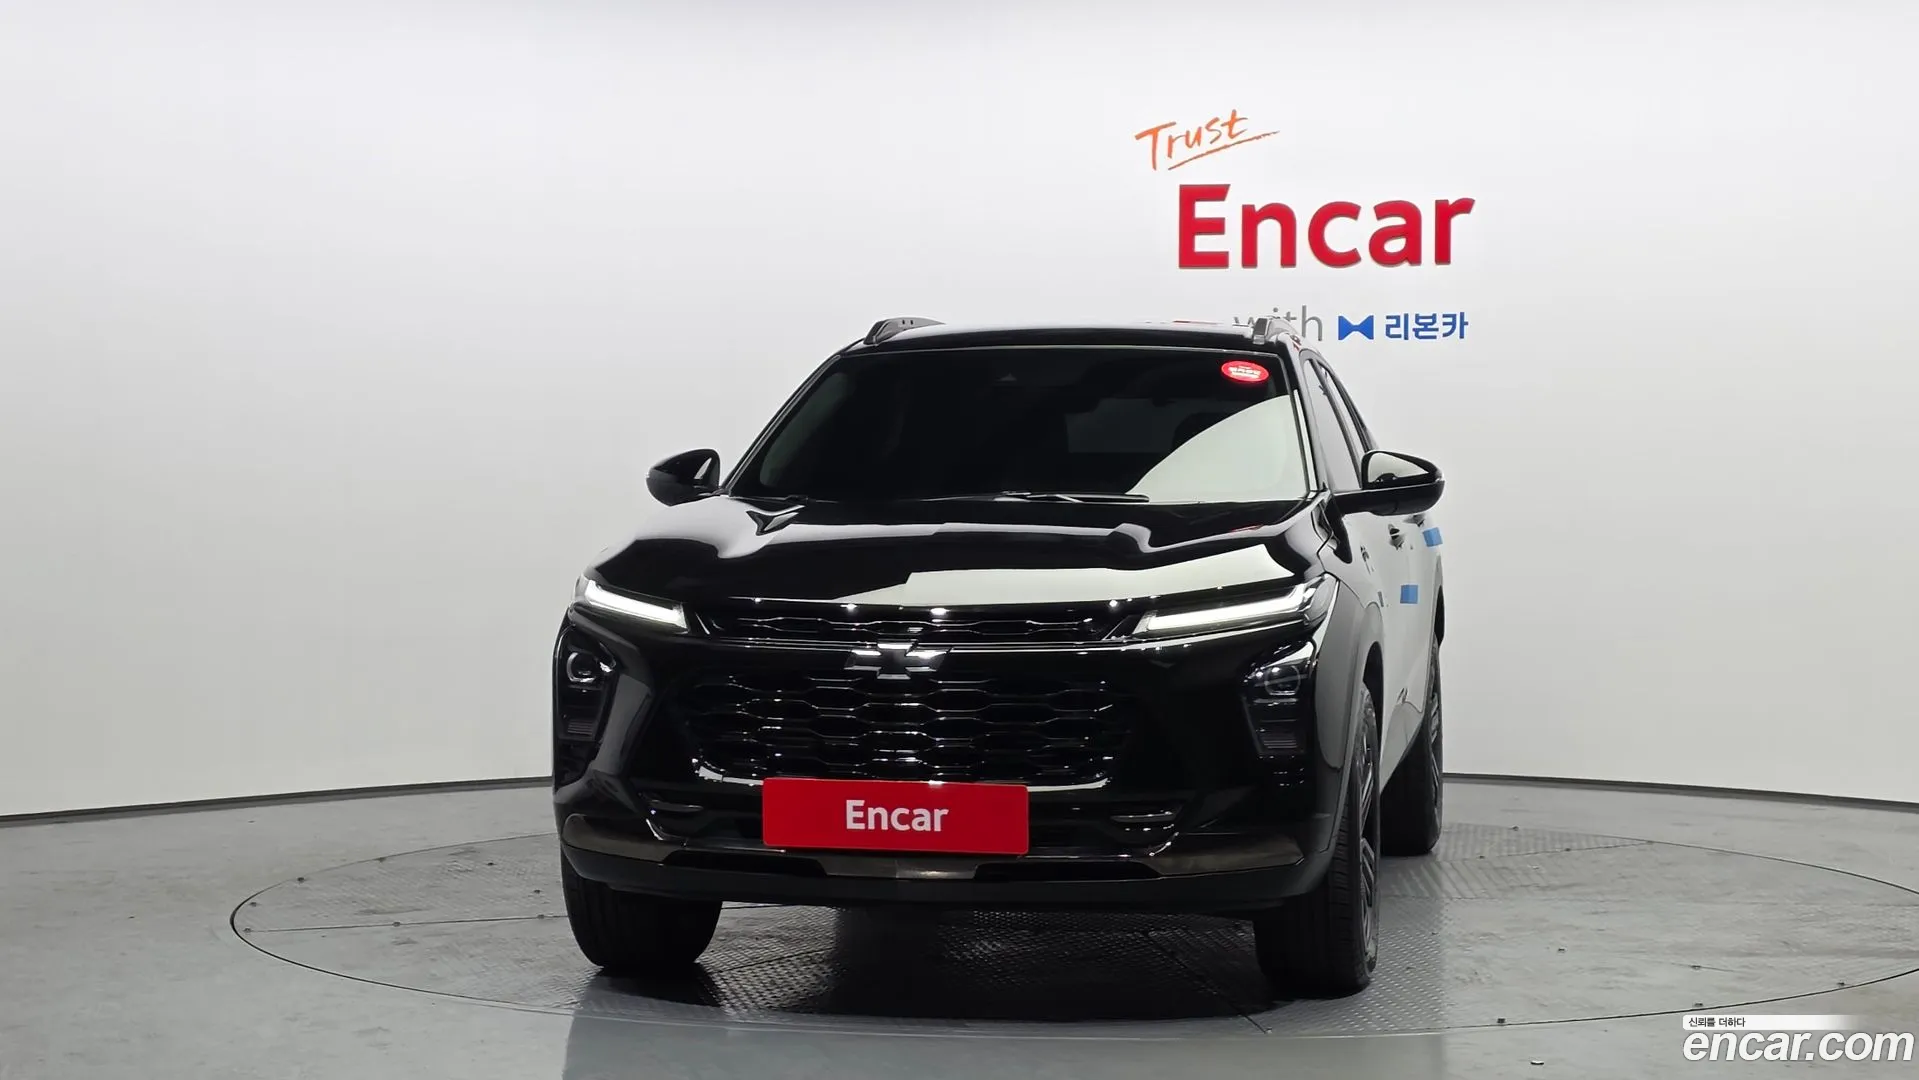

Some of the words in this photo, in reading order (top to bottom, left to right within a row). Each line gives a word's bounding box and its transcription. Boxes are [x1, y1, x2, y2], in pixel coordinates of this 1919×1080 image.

[1135, 109, 1248, 170] Trust
[1178, 183, 1475, 269] Encar
[1384, 311, 1469, 341] 리본카
[846, 799, 949, 832] Encar
